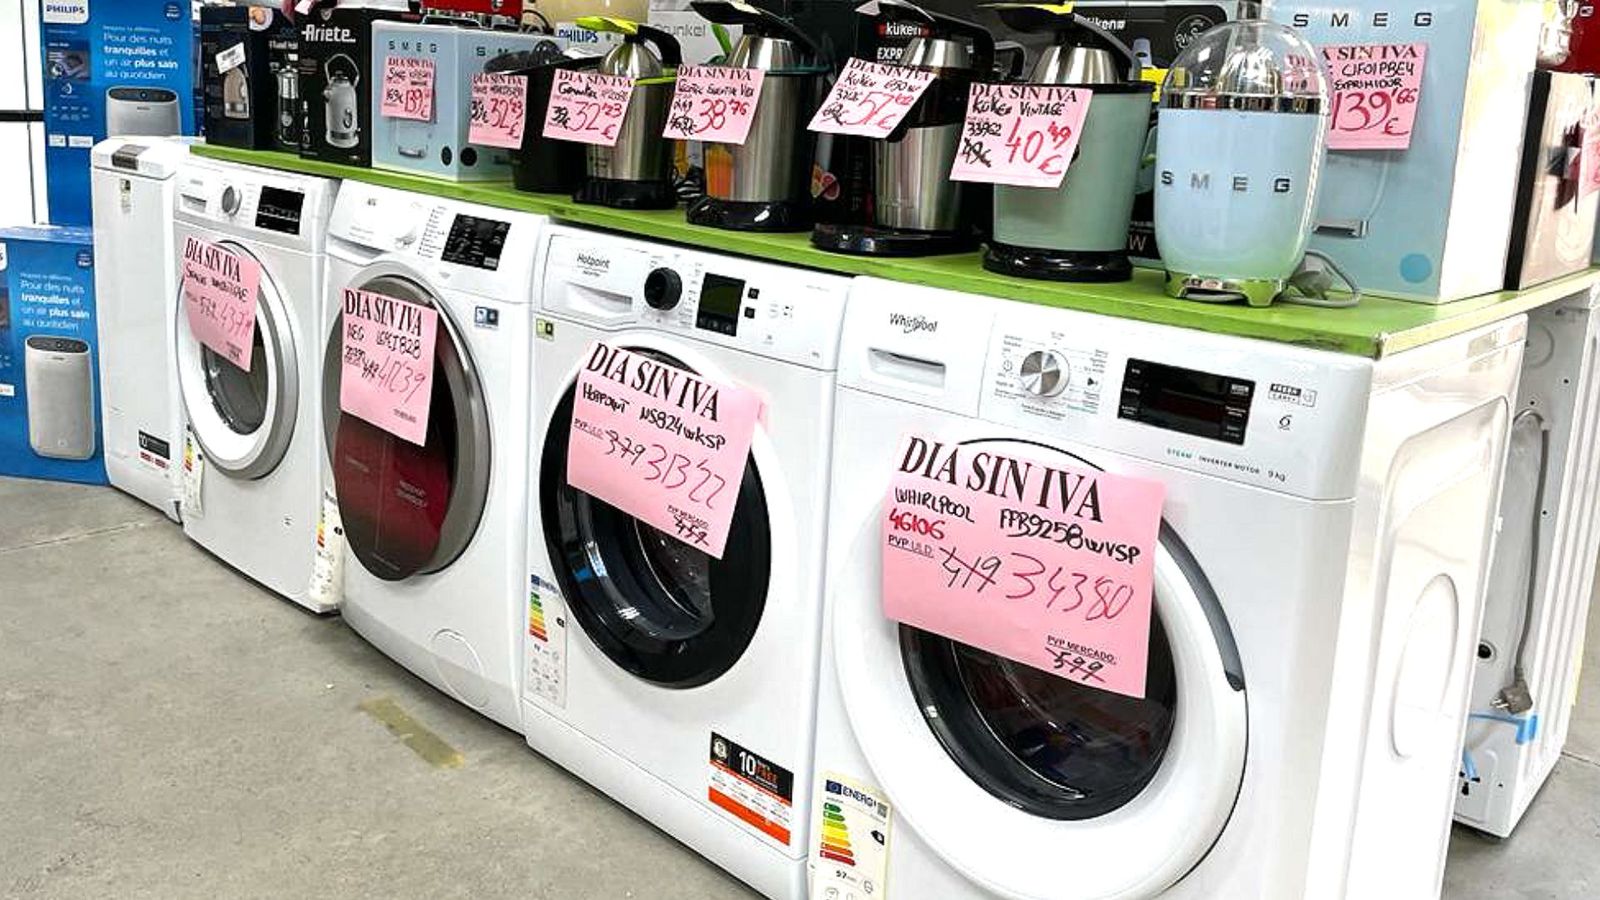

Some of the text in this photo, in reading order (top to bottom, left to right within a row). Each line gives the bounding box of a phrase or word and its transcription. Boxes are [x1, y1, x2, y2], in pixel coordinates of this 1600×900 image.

[46, 4, 85, 14] PHILIPS
[1293, 12, 1433, 27] SMEG
[103, 32, 127, 43] Pour
[130, 33, 148, 44] des
[301, 23, 356, 43] Ariete
[558, 29, 598, 43] PHILIPS
[104, 45, 158, 57] tranquilles
[388, 40, 437, 53] SMEG
[1337, 46, 1373, 60] SIN
[1382, 45, 1418, 59] IVA
[134, 59, 156, 70] plus
[158, 60, 179, 70] sain
[850, 59, 930, 82] DIA SIN IVA
[559, 71, 583, 84] DIA
[587, 75, 609, 87] SIN
[680, 66, 752, 81] DIA SIN IVA
[972, 84, 1077, 103] DIA SIN IVA
[1038, 155, 1062, 175] €
[1160, 170, 1291, 194] SMEG
[185, 237, 204, 265] DIA
[204, 245, 222, 273] SIN
[223, 254, 241, 283] IVA
[49, 307, 69, 319] plus
[345, 289, 422, 337] DIA SIN IVA
[889, 312, 938, 334] Whirlpool
[586, 342, 719, 422] DIA SIN IVA
[1167, 448, 1193, 459] STEAM
[1199, 455, 1234, 468] INVERTER
[1234, 462, 1260, 475] MOTOR
[899, 436, 1104, 523] DIA SIN IVA
[895, 487, 976, 524] WHIRLPOOL
[888, 534, 909, 549] PVP
[1047, 634, 1065, 648] PVP
[739, 750, 756, 776] 10
